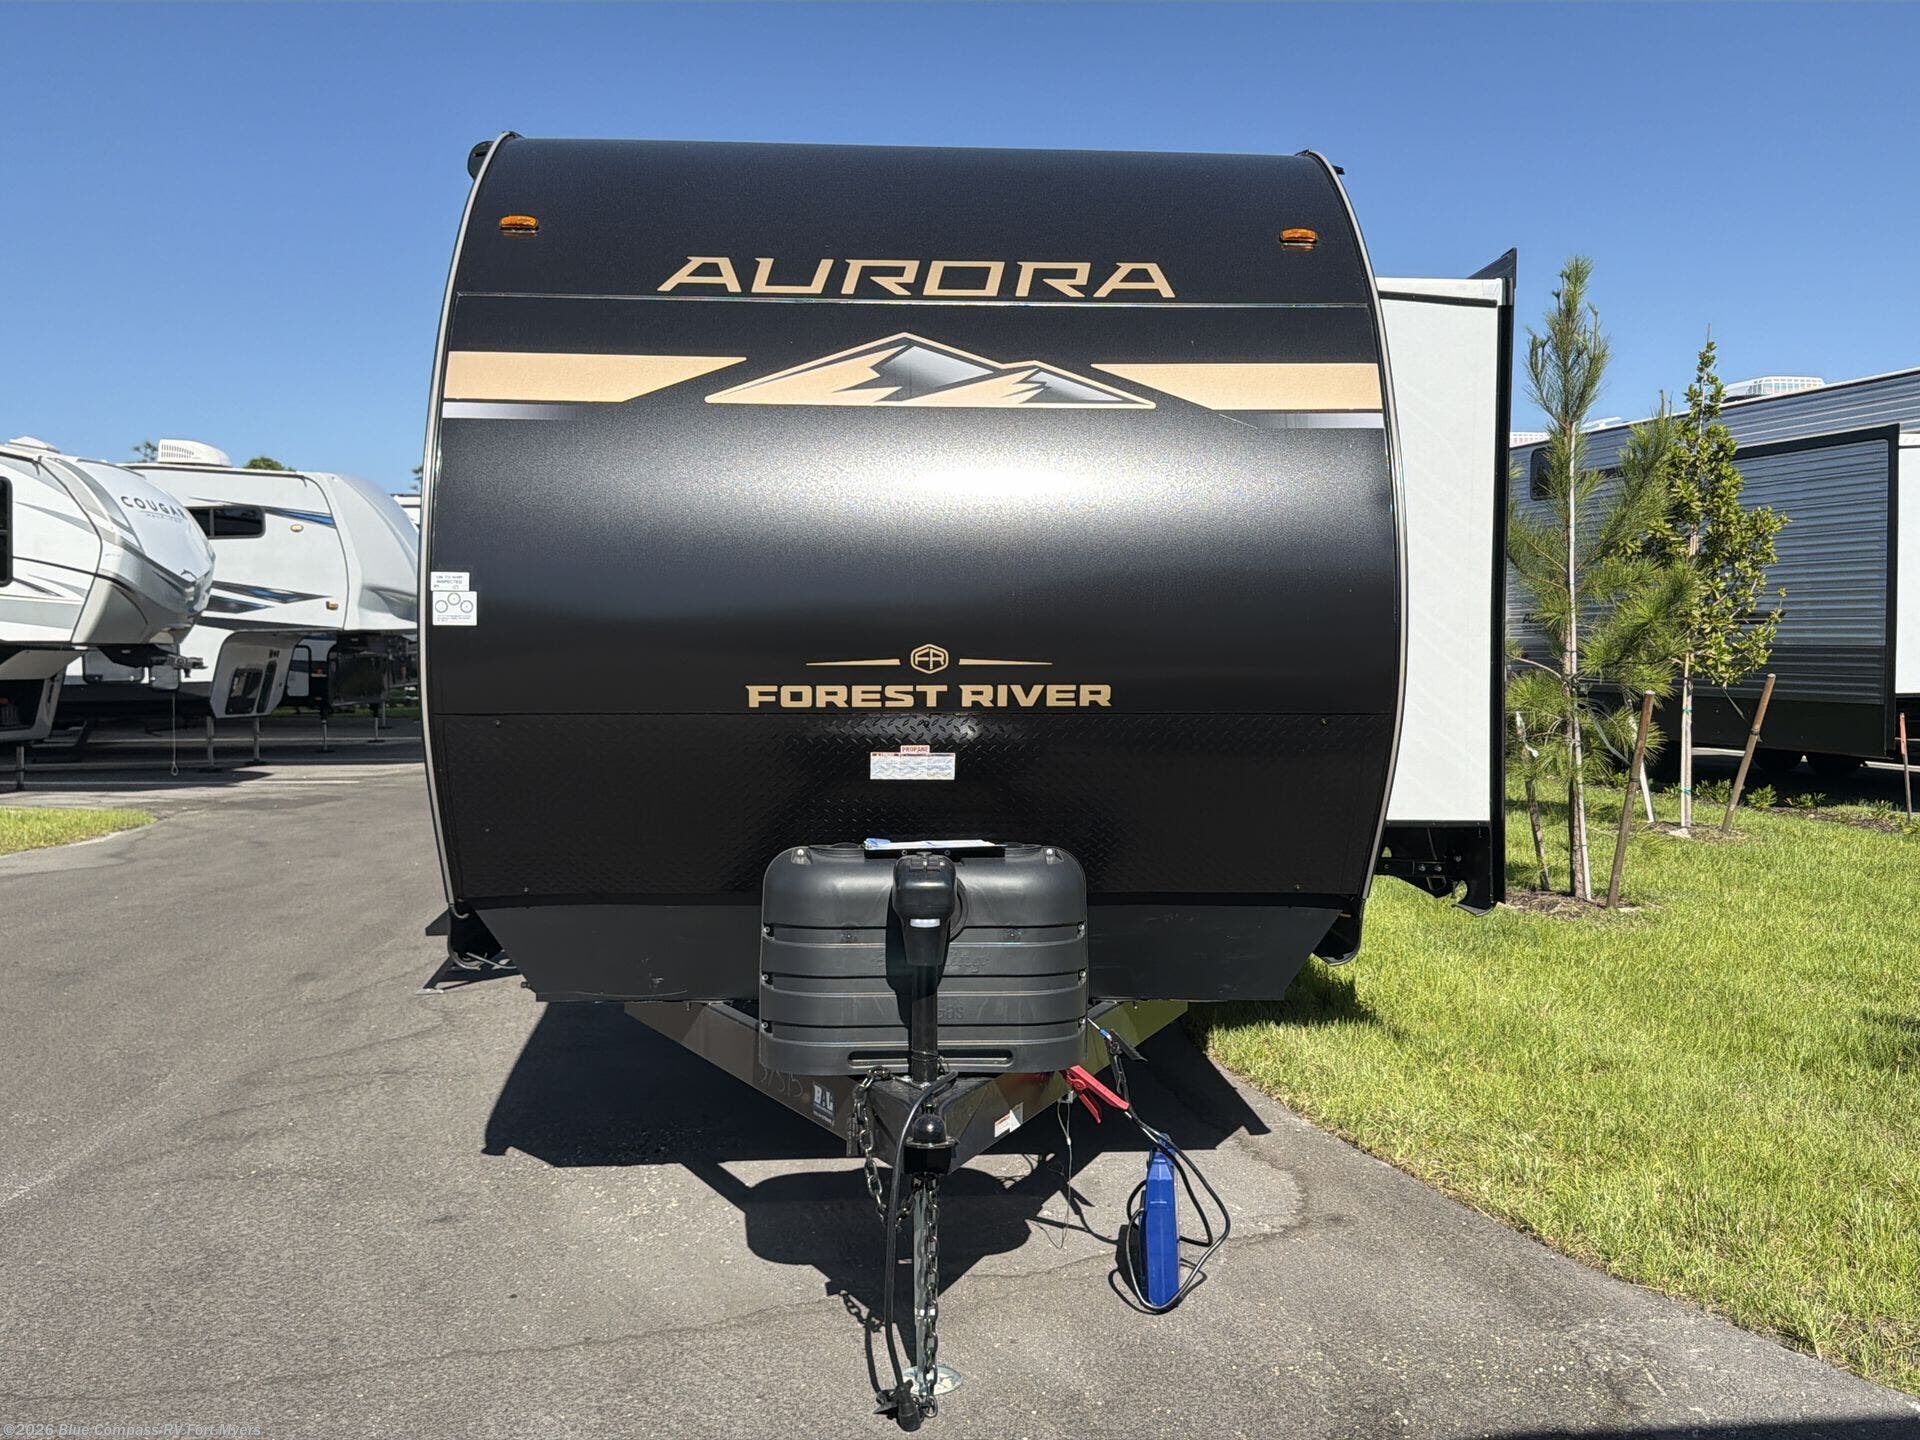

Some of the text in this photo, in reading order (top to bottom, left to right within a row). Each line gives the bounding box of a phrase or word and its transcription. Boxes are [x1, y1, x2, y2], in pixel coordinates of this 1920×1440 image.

[657, 256, 1176, 298] AURORA
[745, 684, 1112, 708] FOREST RIVER
